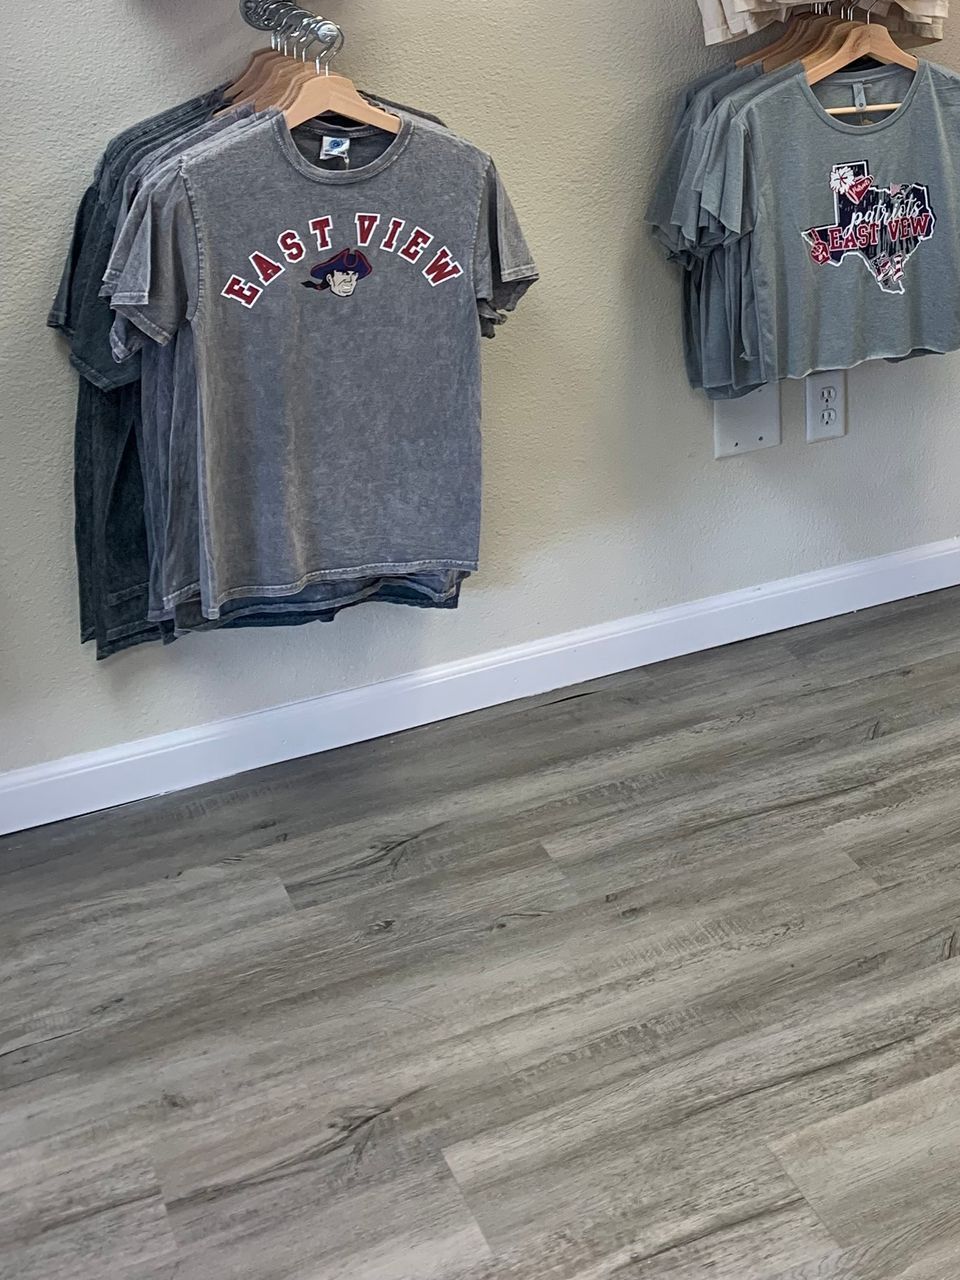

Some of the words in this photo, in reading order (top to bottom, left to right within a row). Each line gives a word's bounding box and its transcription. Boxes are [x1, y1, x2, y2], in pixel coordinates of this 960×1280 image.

[828, 223, 880, 252] EAST
[842, 193, 924, 239] patriots
[221, 214, 333, 309] EAST
[355, 212, 464, 287] VIEW
